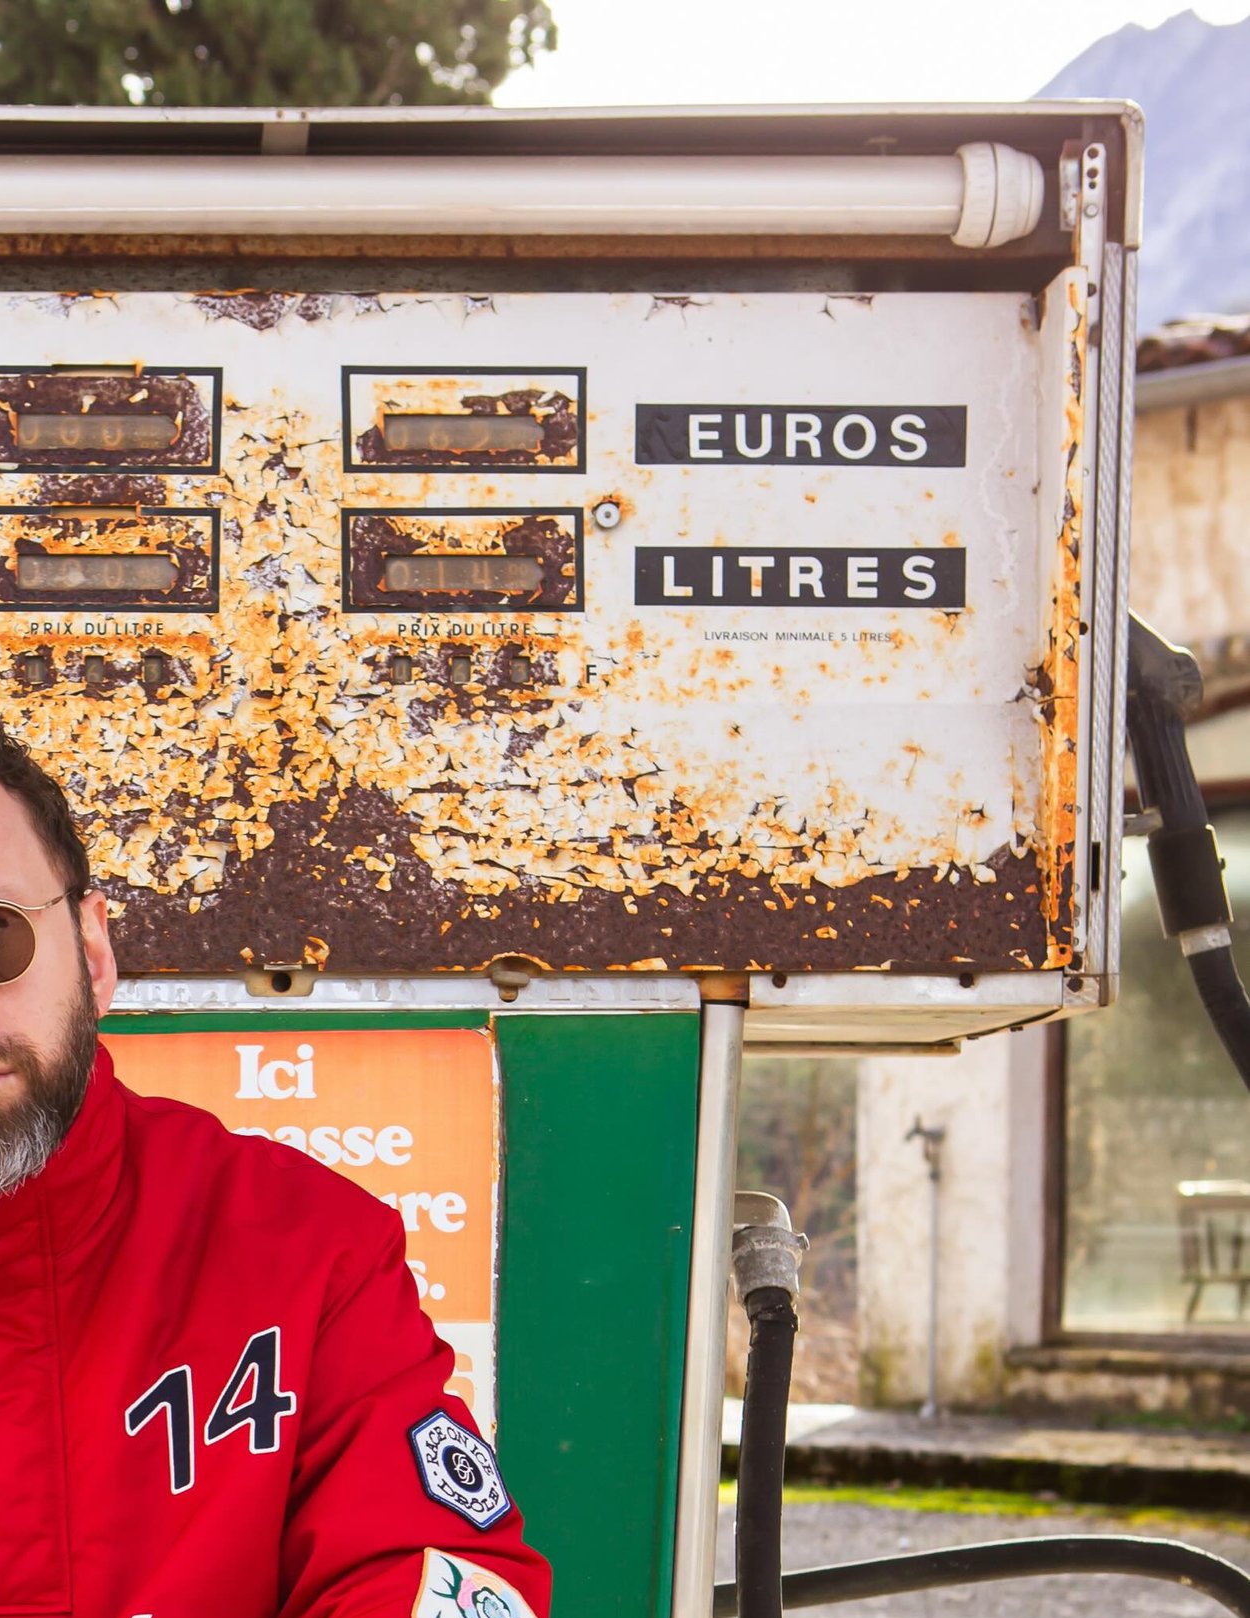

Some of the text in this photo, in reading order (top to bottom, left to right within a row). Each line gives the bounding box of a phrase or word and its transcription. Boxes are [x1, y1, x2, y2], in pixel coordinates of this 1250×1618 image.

[688, 413, 928, 460] EUROS
[663, 555, 937, 600] LITRES
[30, 622, 165, 636] PRIX DU LITRE
[397, 623, 532, 637] PRIX DU LITRE
[704, 631, 892, 643] LIVRAISON MINIMALE 5 LITRES
[220, 665, 232, 684] F
[586, 664, 598, 684] F
[235, 1043, 317, 1100] Ici
[126, 1326, 297, 1494] 14
[426, 1425, 494, 1476] RACE ON ICE
